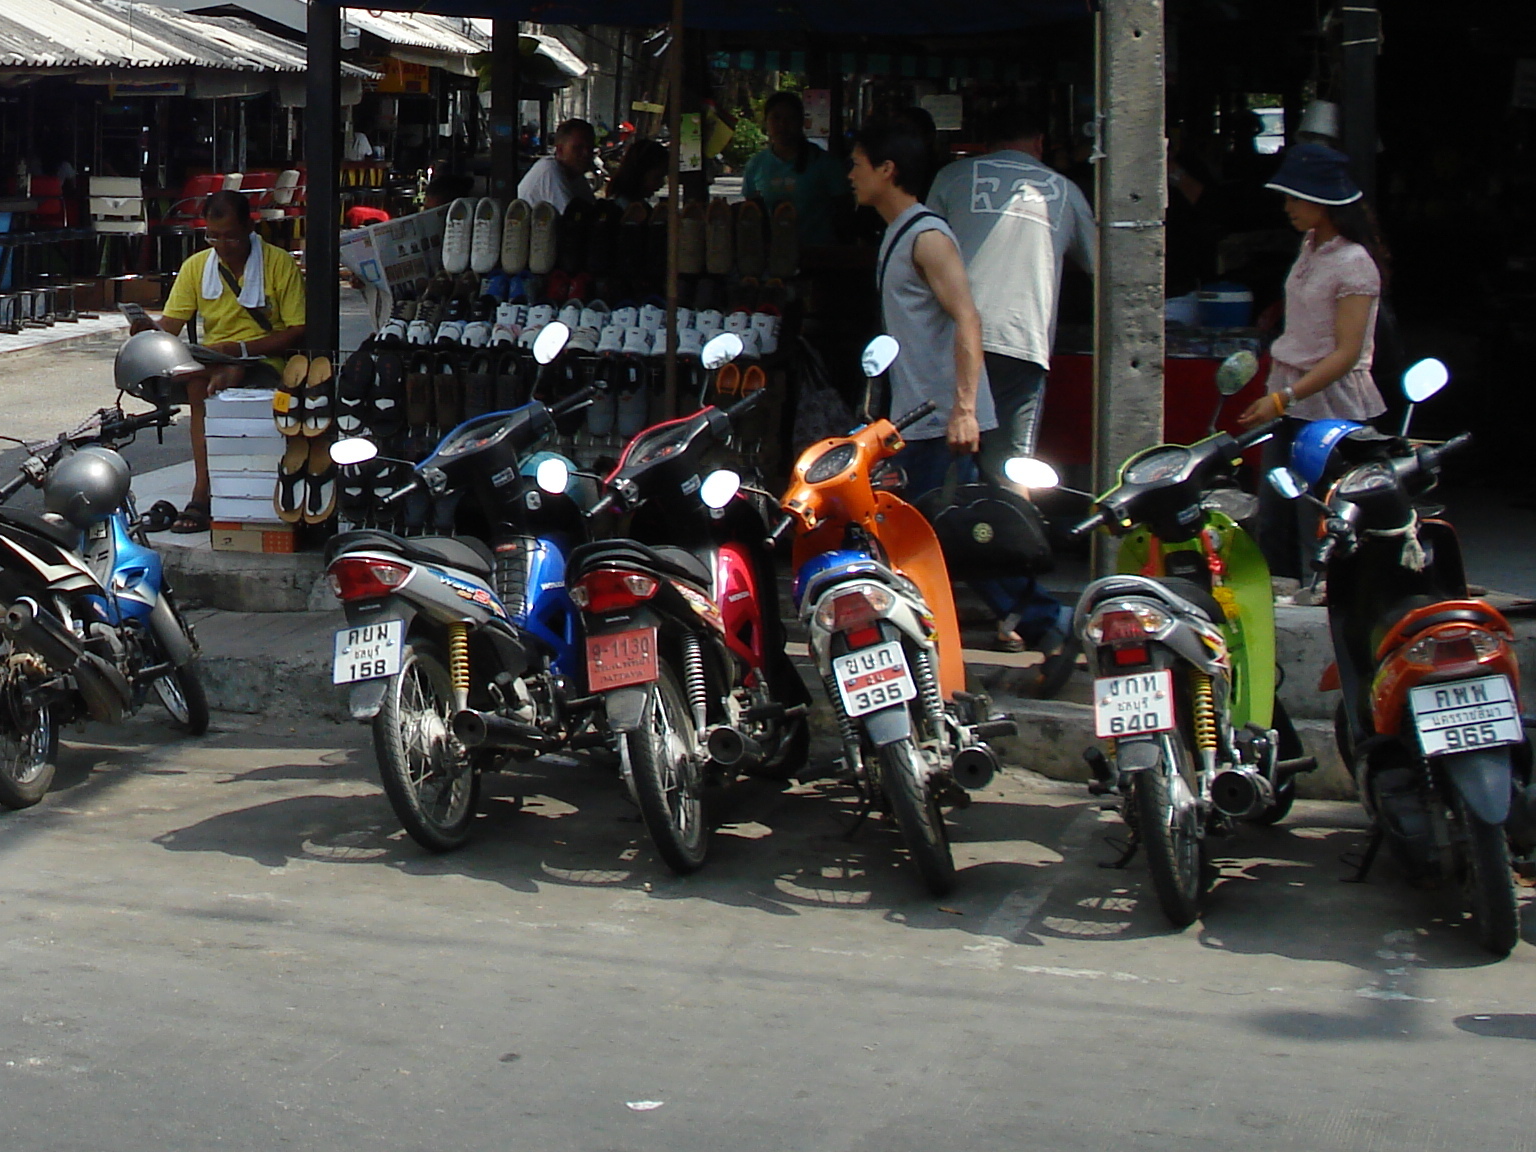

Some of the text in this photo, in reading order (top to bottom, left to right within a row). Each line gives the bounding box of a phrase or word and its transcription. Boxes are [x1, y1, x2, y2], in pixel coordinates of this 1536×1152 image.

[350, 659, 386, 680] 158
[855, 682, 903, 710] 335
[1110, 712, 1159, 734] 640
[1445, 723, 1498, 749] 965
